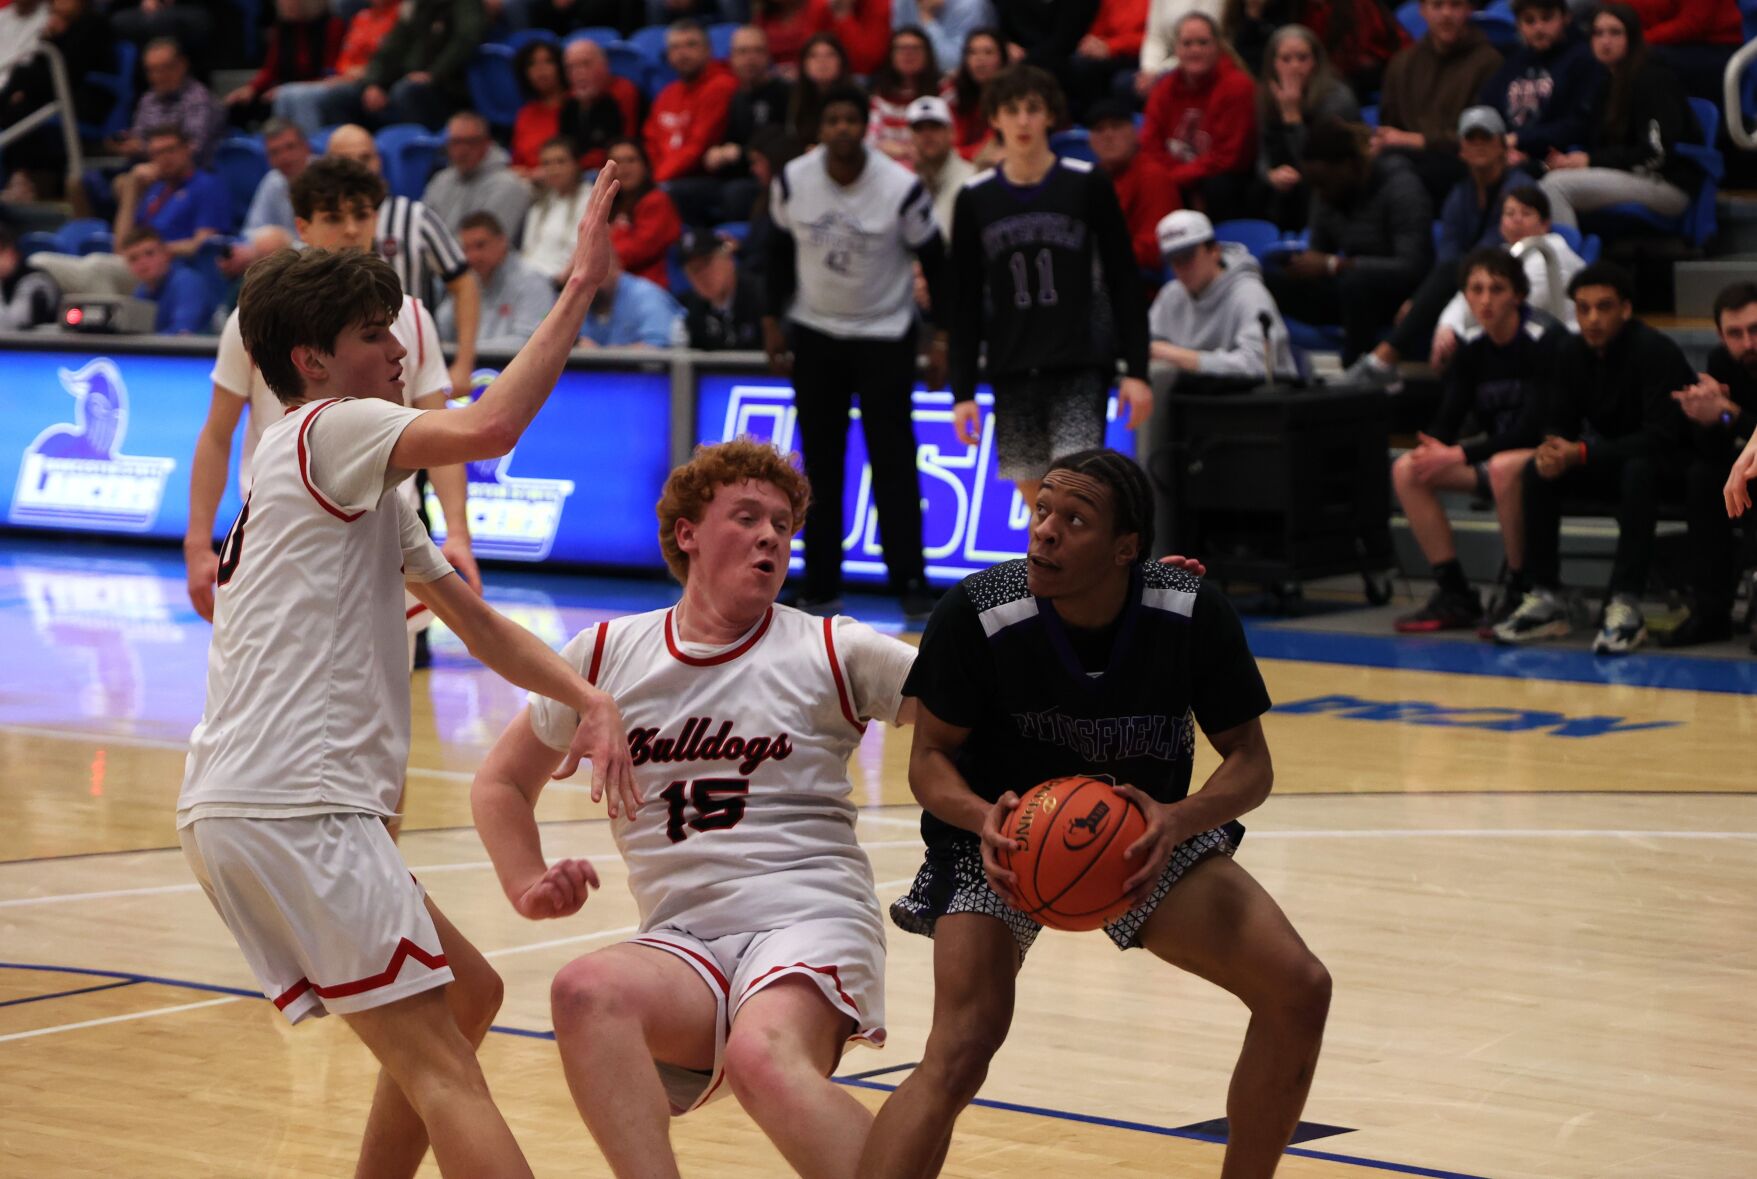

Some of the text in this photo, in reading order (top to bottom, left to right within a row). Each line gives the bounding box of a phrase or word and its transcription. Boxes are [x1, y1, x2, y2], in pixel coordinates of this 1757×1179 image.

[1008, 248, 1058, 310] 11
[628, 717, 792, 775] Bulldogs
[660, 778, 749, 843] 15
